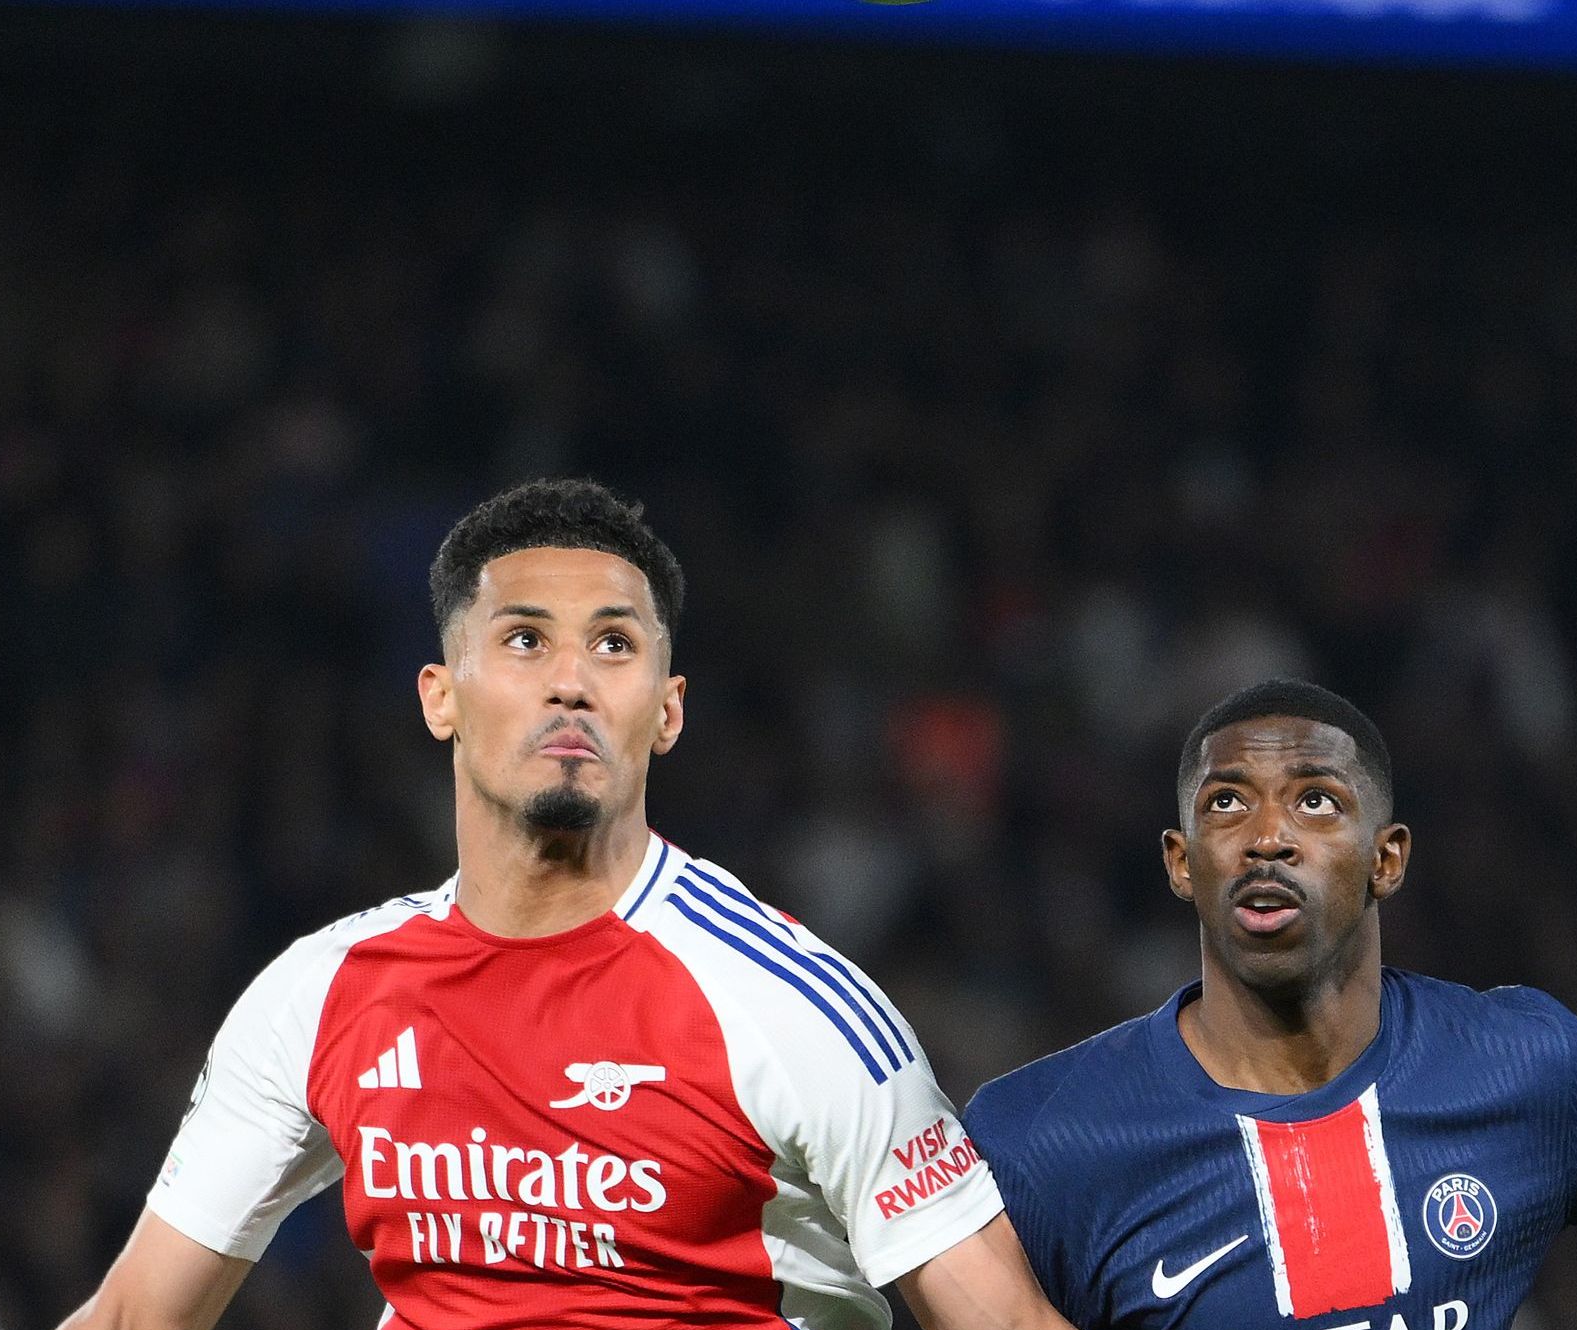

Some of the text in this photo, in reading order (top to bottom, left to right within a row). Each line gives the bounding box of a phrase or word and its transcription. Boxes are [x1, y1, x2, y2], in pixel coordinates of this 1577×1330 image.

[358, 1126, 666, 1213] Emirates
[893, 1118, 948, 1170] VISIT
[1431, 1178, 1480, 1203] PARIS
[408, 1212, 625, 1268] FLY BETTER
